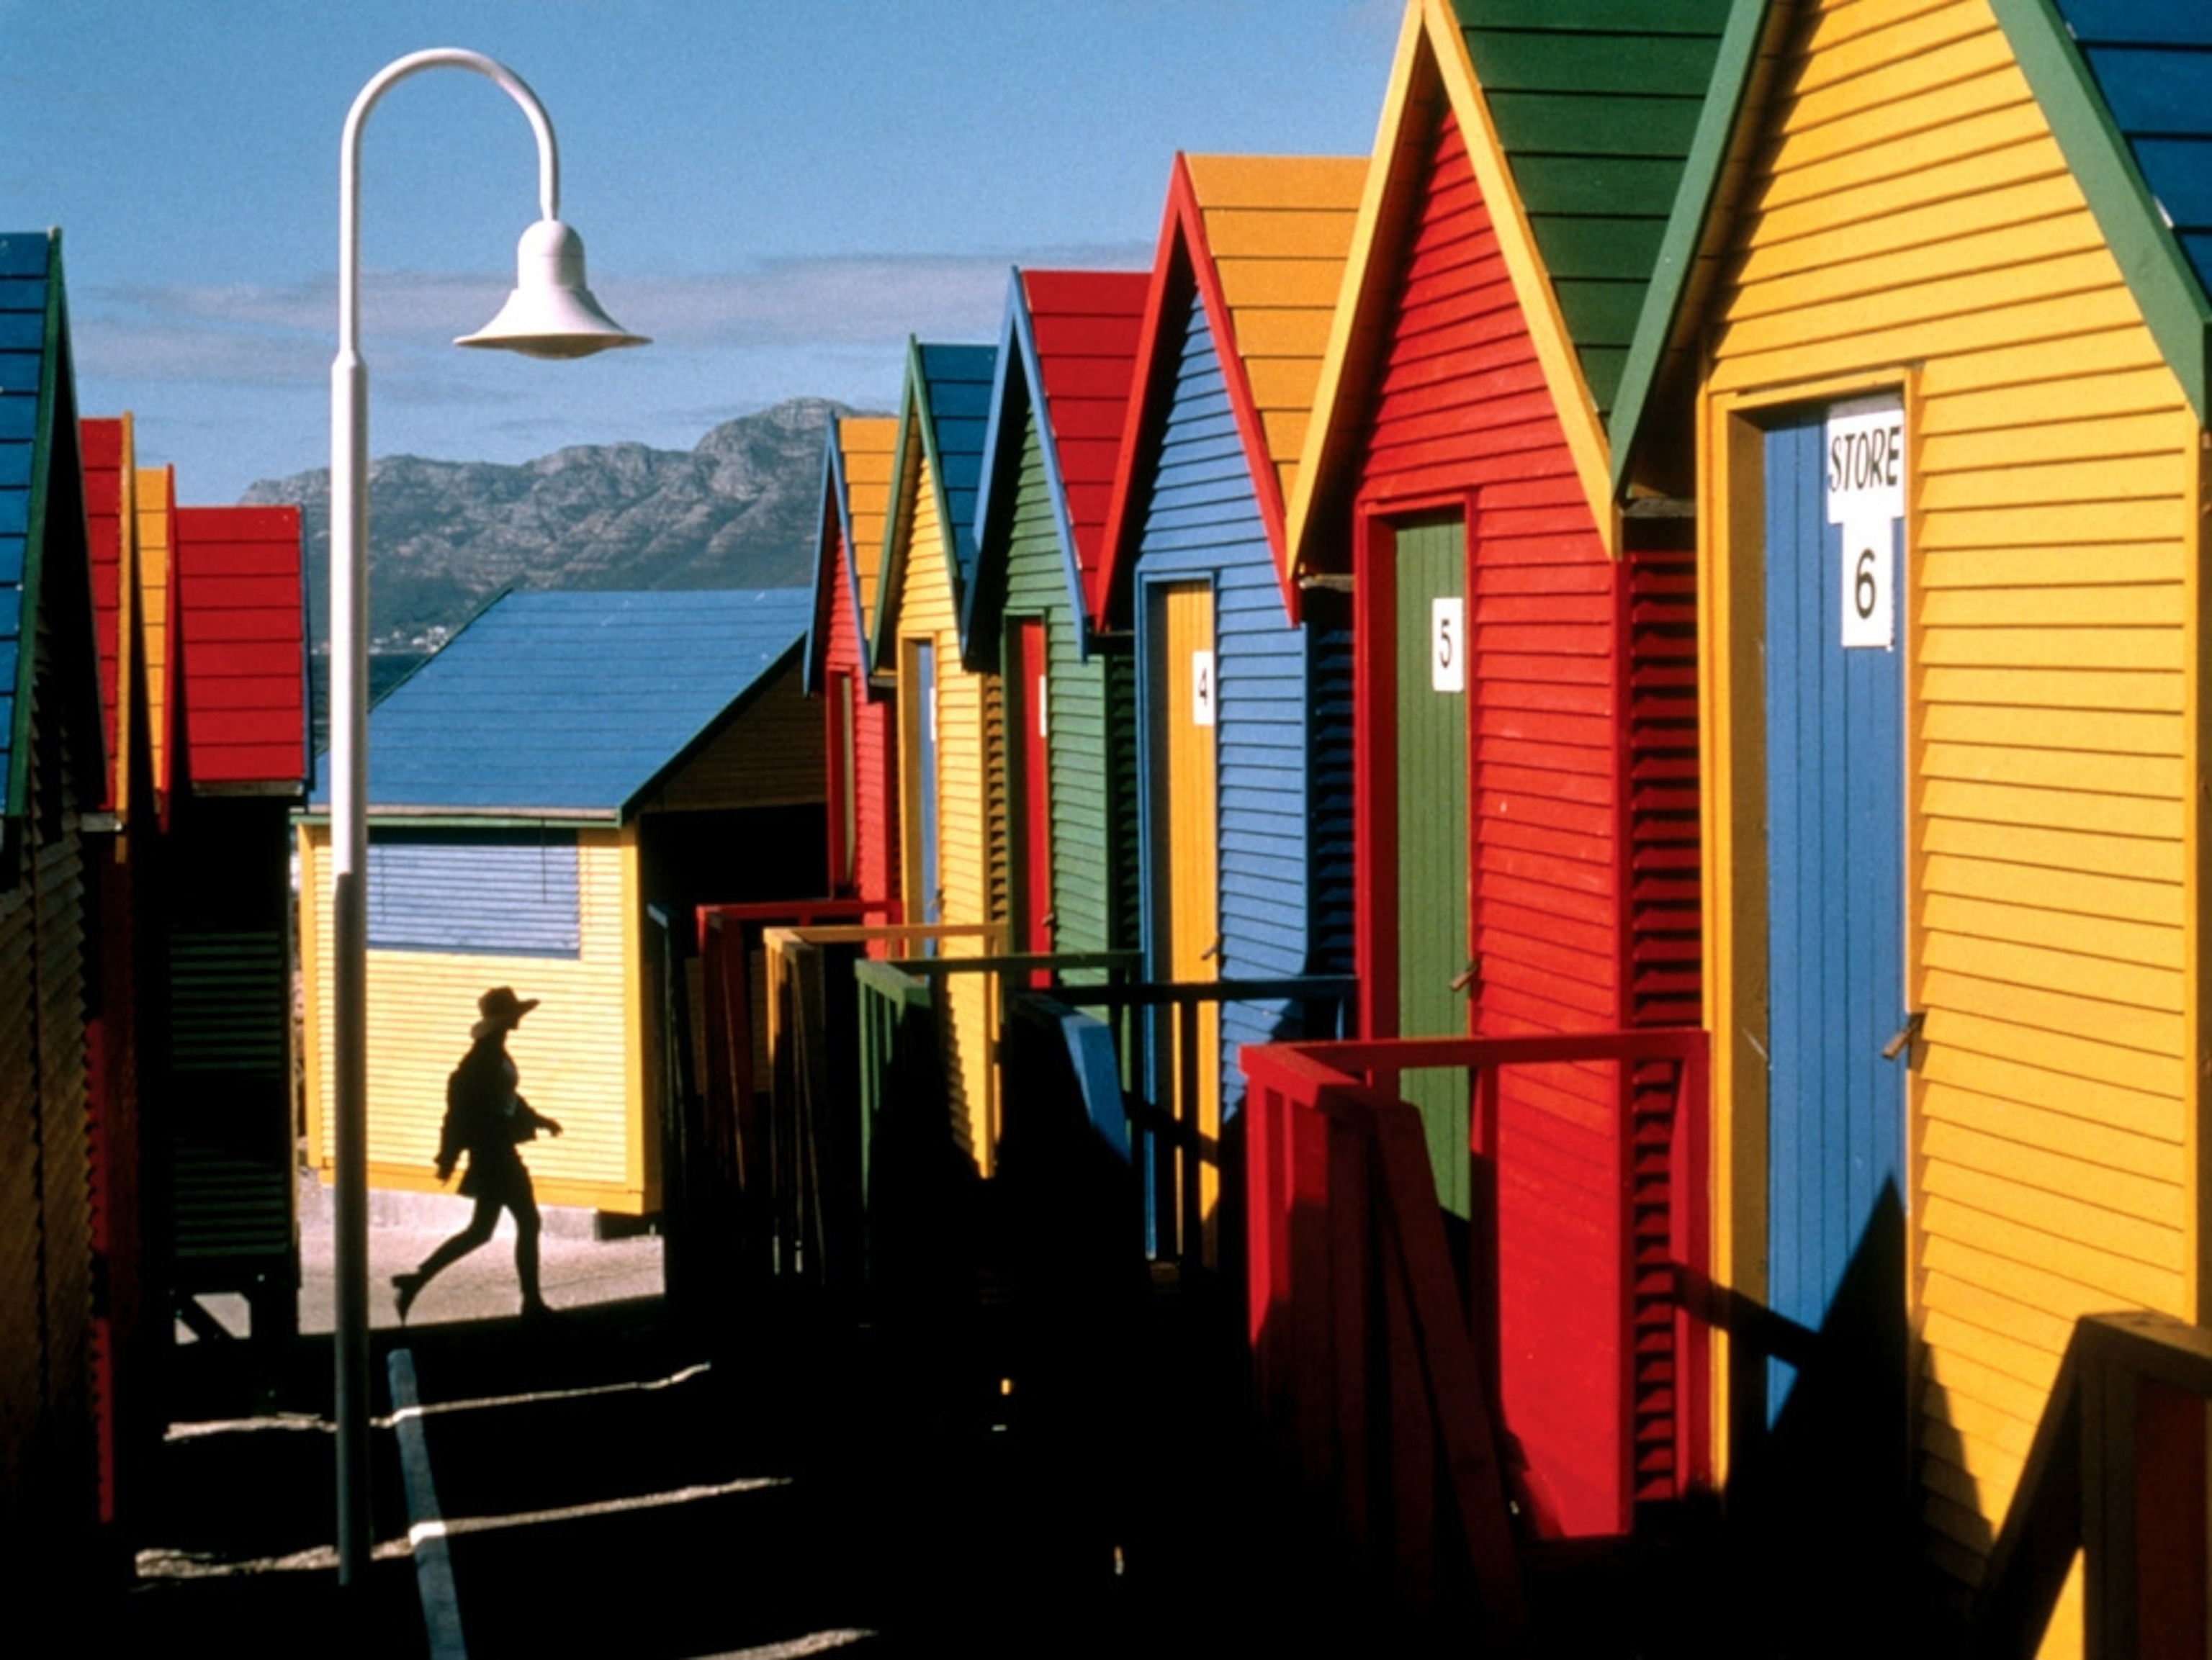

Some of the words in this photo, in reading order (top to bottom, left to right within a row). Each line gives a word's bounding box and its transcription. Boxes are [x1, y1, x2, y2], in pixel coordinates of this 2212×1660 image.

[1829, 425, 1901, 492] STORE
[1855, 548, 1876, 619] 6
[1439, 618, 1452, 668] 5
[1199, 667, 1208, 706] 4
